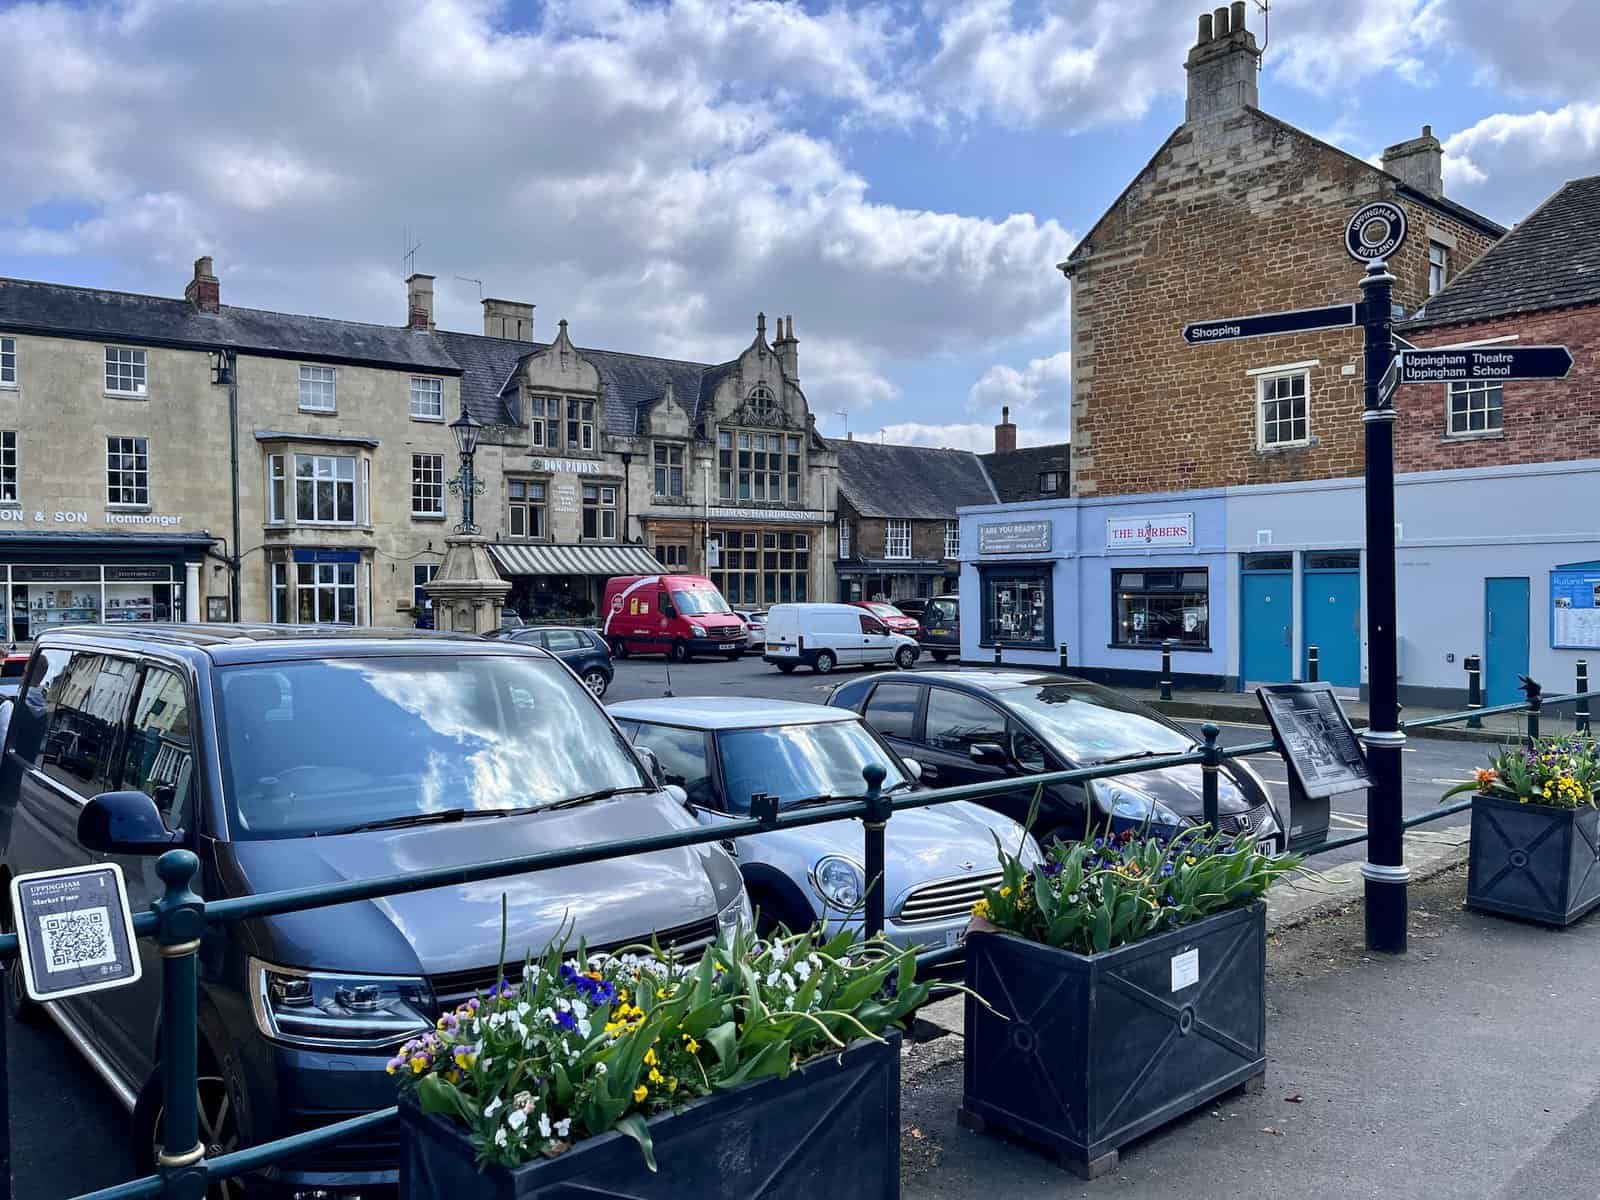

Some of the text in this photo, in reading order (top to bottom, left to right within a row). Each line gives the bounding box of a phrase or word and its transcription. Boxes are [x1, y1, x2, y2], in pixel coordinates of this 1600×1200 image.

[1351, 207, 1397, 230] UPPINGHAM
[1357, 239, 1394, 256] RUTLAND
[1192, 324, 1240, 338] Shopping
[1406, 353, 1514, 367] Uppingham Theatre
[1406, 365, 1511, 379] Uppingham School
[544, 460, 562, 473] DON
[34, 511, 44, 522] &
[54, 511, 88, 523] SON
[106, 512, 183, 526] Ironmonger
[751, 509, 816, 520] HAIRDRESSING
[999, 525, 1013, 534] YOU
[1112, 527, 1188, 538] THE BARBERS
[31, 881, 80, 893] UPPINGHAM
[32, 896, 59, 905] Market
